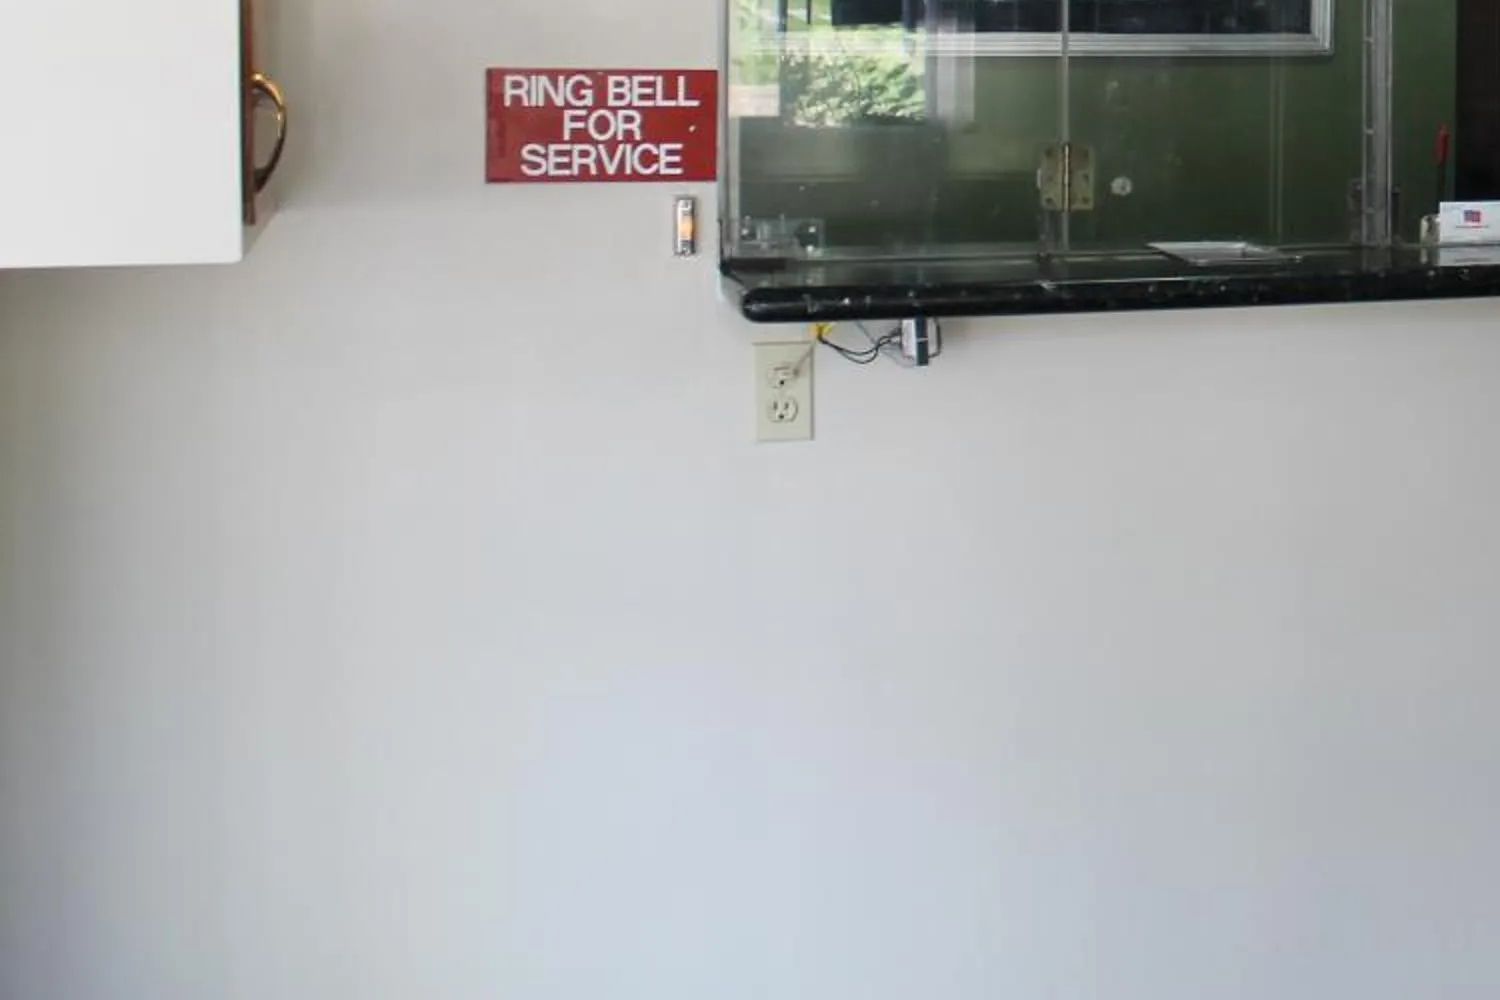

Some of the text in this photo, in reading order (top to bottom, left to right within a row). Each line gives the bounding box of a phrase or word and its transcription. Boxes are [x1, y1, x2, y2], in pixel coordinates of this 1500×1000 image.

[503, 75, 700, 107] RING BELL
[563, 109, 642, 141] FOR
[520, 143, 683, 177] SERVICE
